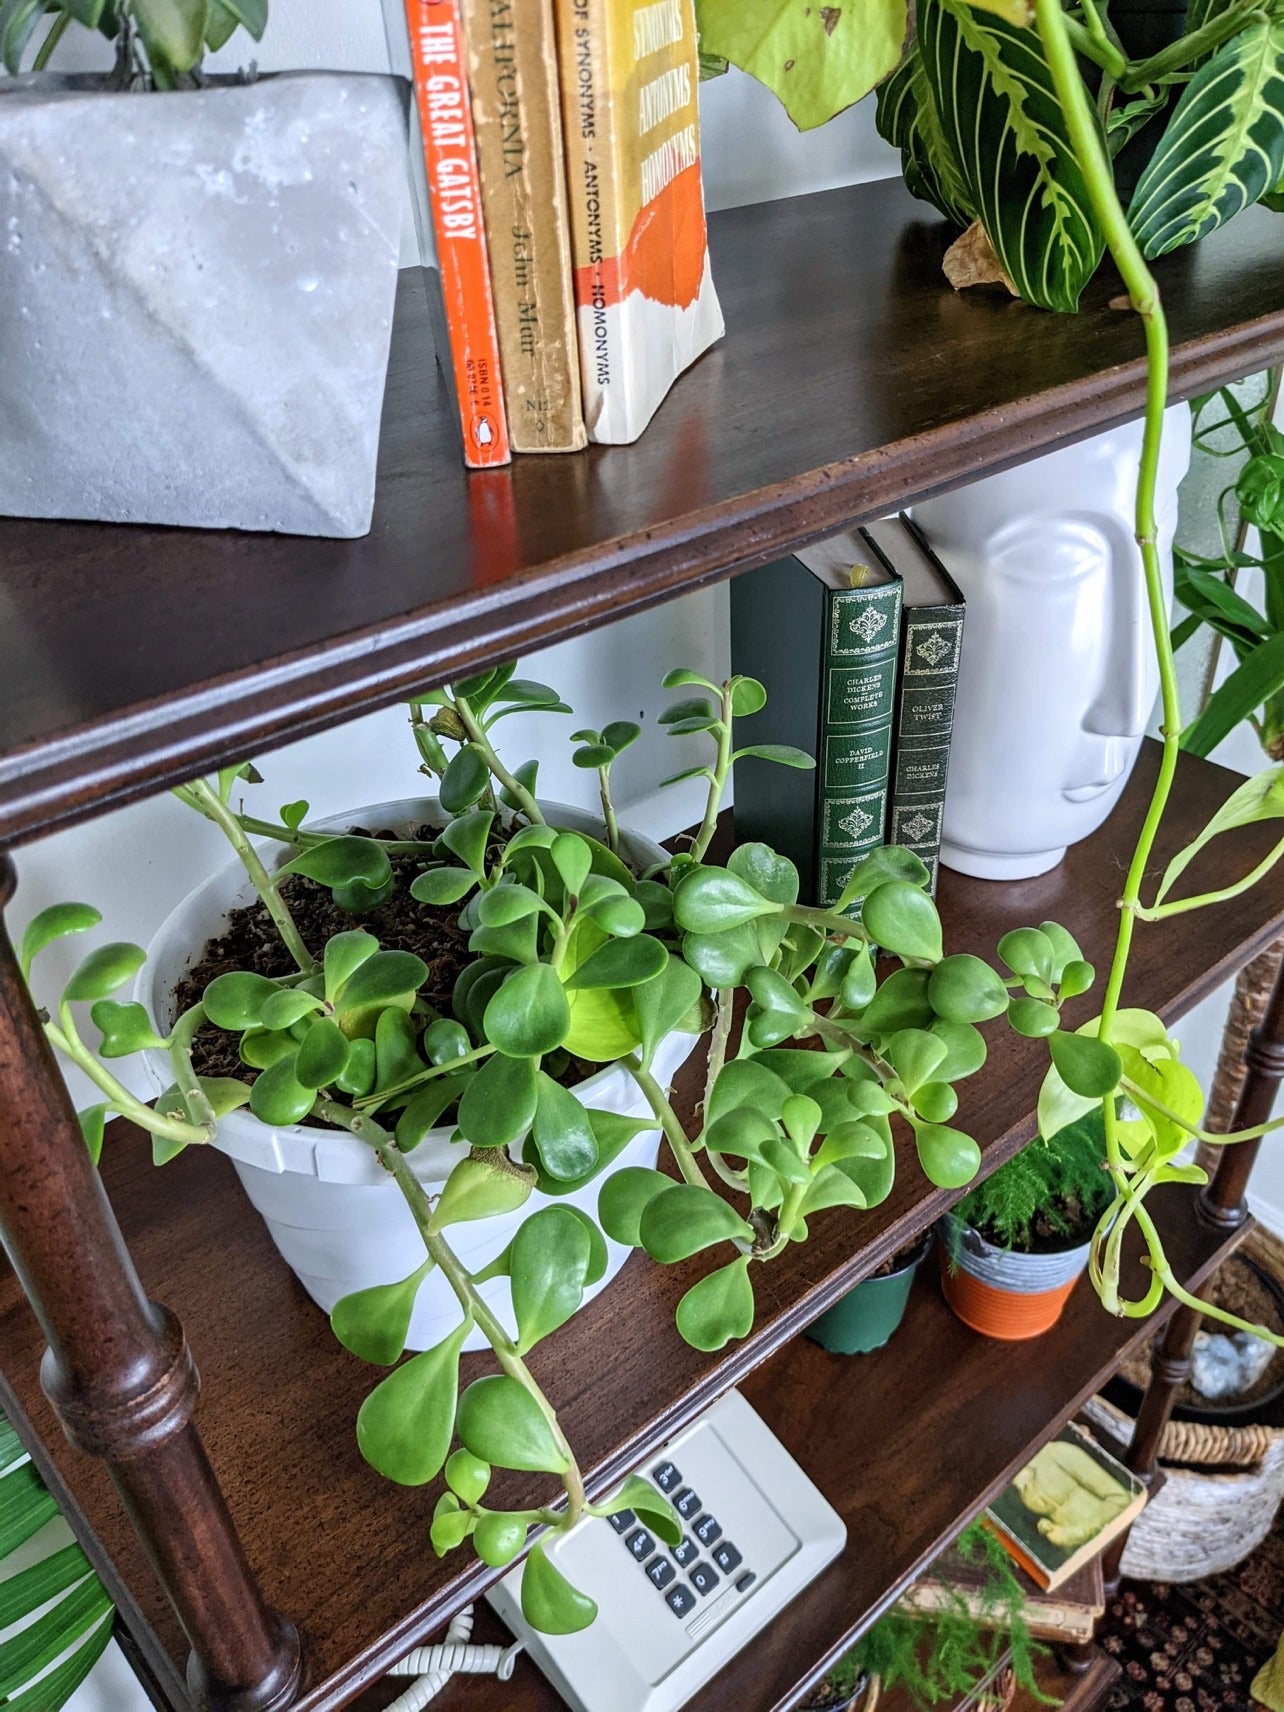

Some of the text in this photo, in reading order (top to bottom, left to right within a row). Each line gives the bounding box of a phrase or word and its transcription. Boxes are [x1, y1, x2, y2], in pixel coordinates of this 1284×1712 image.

[639, 63, 691, 137] ANTONYMS
[419, 22, 477, 239] THE GREAT GATSBY
[640, 124, 697, 208] HOMONYMS
[574, 0, 610, 385] OF SYNONYMS ANTONYMS HOMONYMS
[512, 225, 539, 357] John Muir
[478, 359, 488, 384] ISBN
[482, 396, 491, 407] 14
[847, 674, 882, 686] CHARLES
[847, 682, 881, 693] DICKENS
[844, 691, 883, 704] COMPLETE
[850, 701, 878, 711] WORKS
[912, 704, 944, 713] OLIVER
[914, 712, 942, 721] TWIST
[835, 750, 884, 764] COPPERFIELD
[849, 747, 873, 757] DAVID
[905, 763, 940, 773] CHARLES
[906, 771, 938, 780] DICKENS
